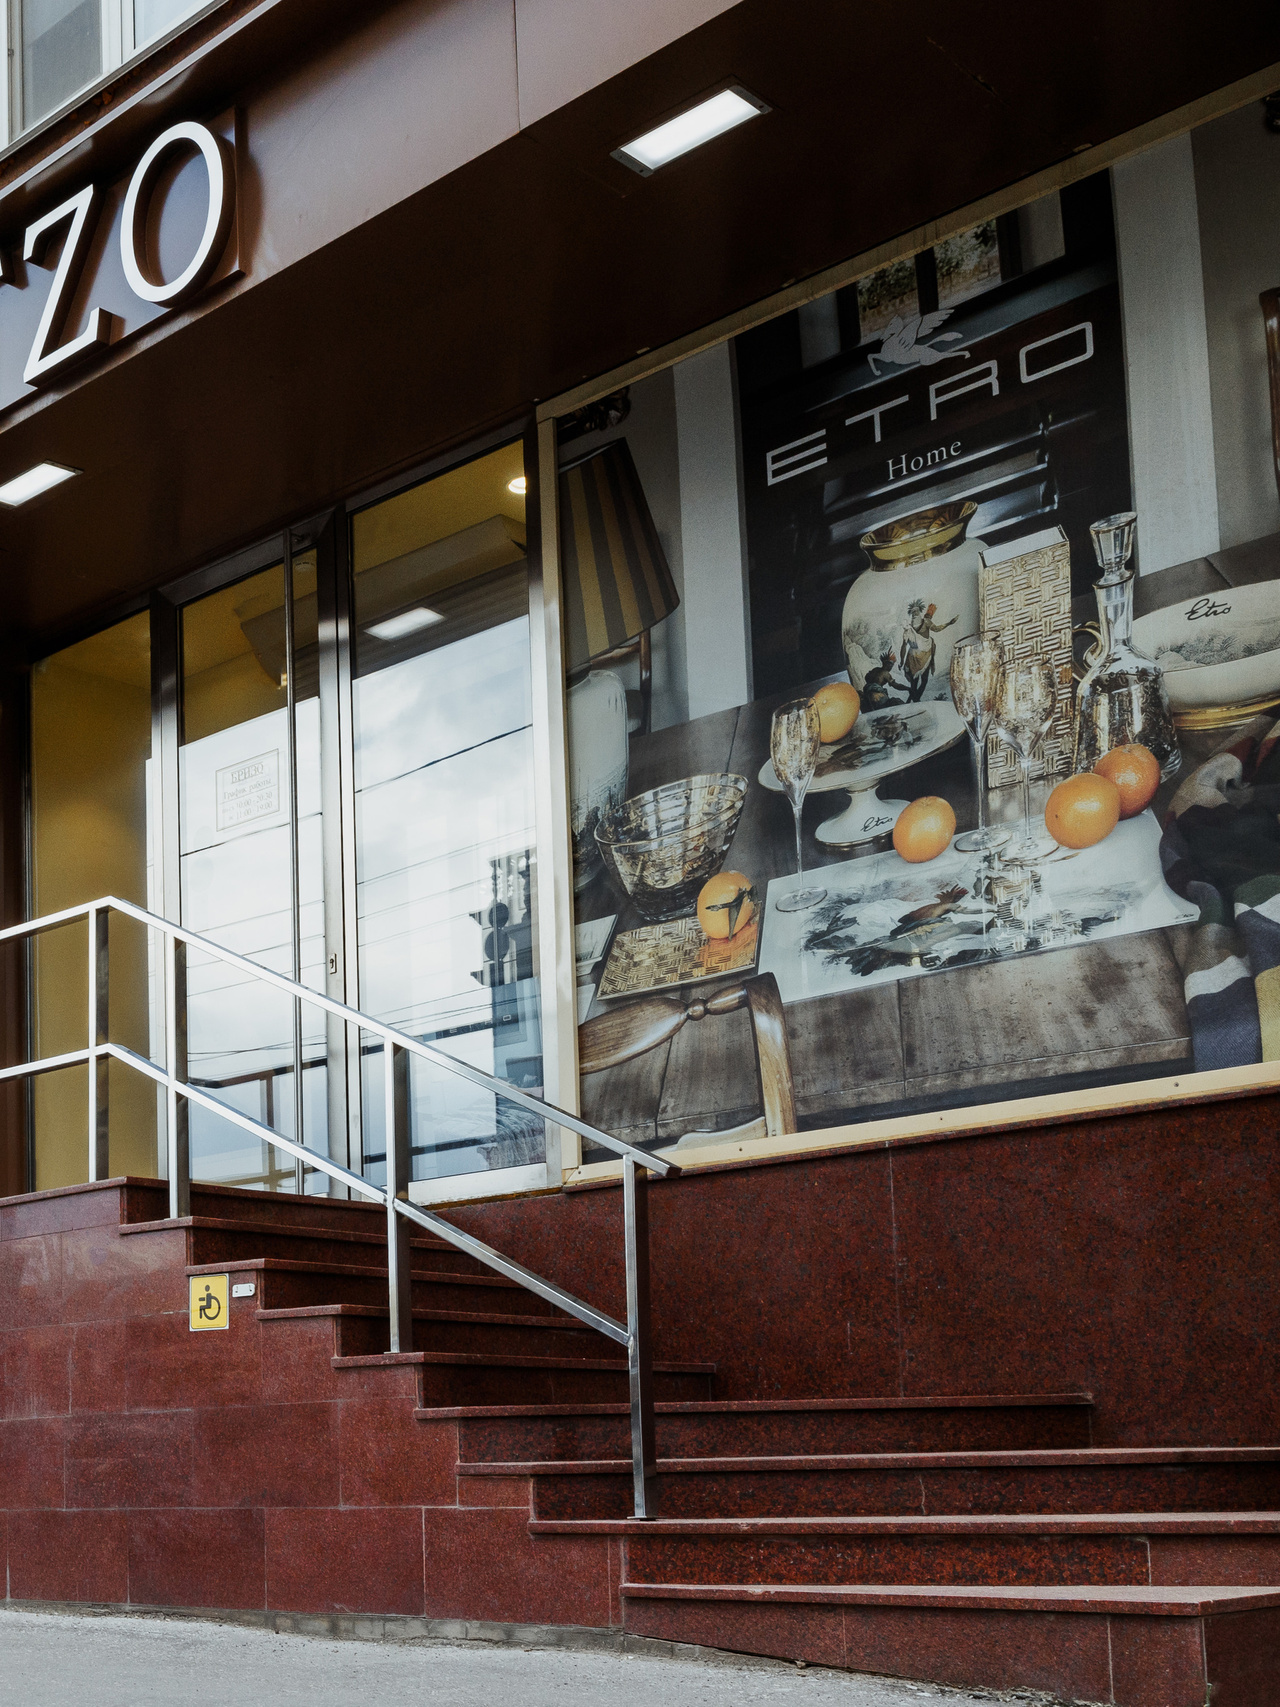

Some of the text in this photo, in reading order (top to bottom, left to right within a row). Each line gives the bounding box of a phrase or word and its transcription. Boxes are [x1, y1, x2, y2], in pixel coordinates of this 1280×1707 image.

[766, 321, 1094, 487] ETRO
[886, 440, 962, 481] Home
[1184, 598, 1232, 621] Etro
[249, 778, 272, 792] работы
[860, 816, 893, 832] Etro
